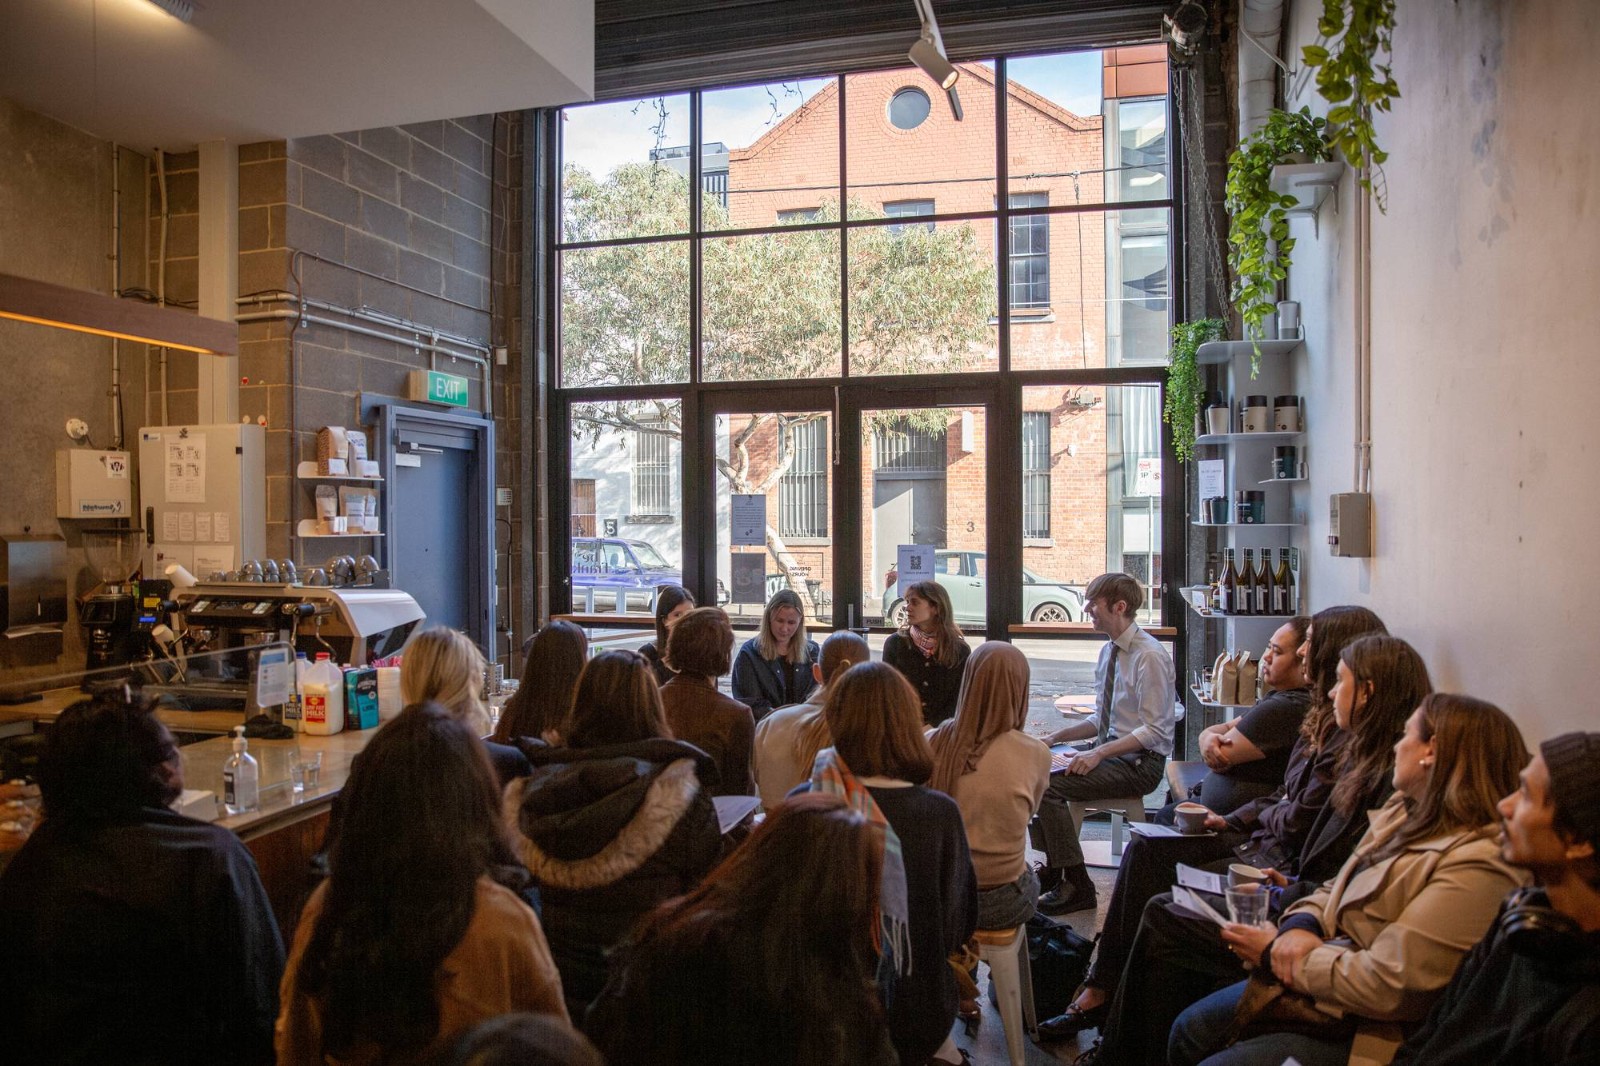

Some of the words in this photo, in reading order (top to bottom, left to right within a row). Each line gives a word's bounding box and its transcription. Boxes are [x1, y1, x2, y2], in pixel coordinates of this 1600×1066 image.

[436, 377, 460, 401] EXIT
[606, 521, 615, 534] 5
[966, 521, 975, 532] 3
